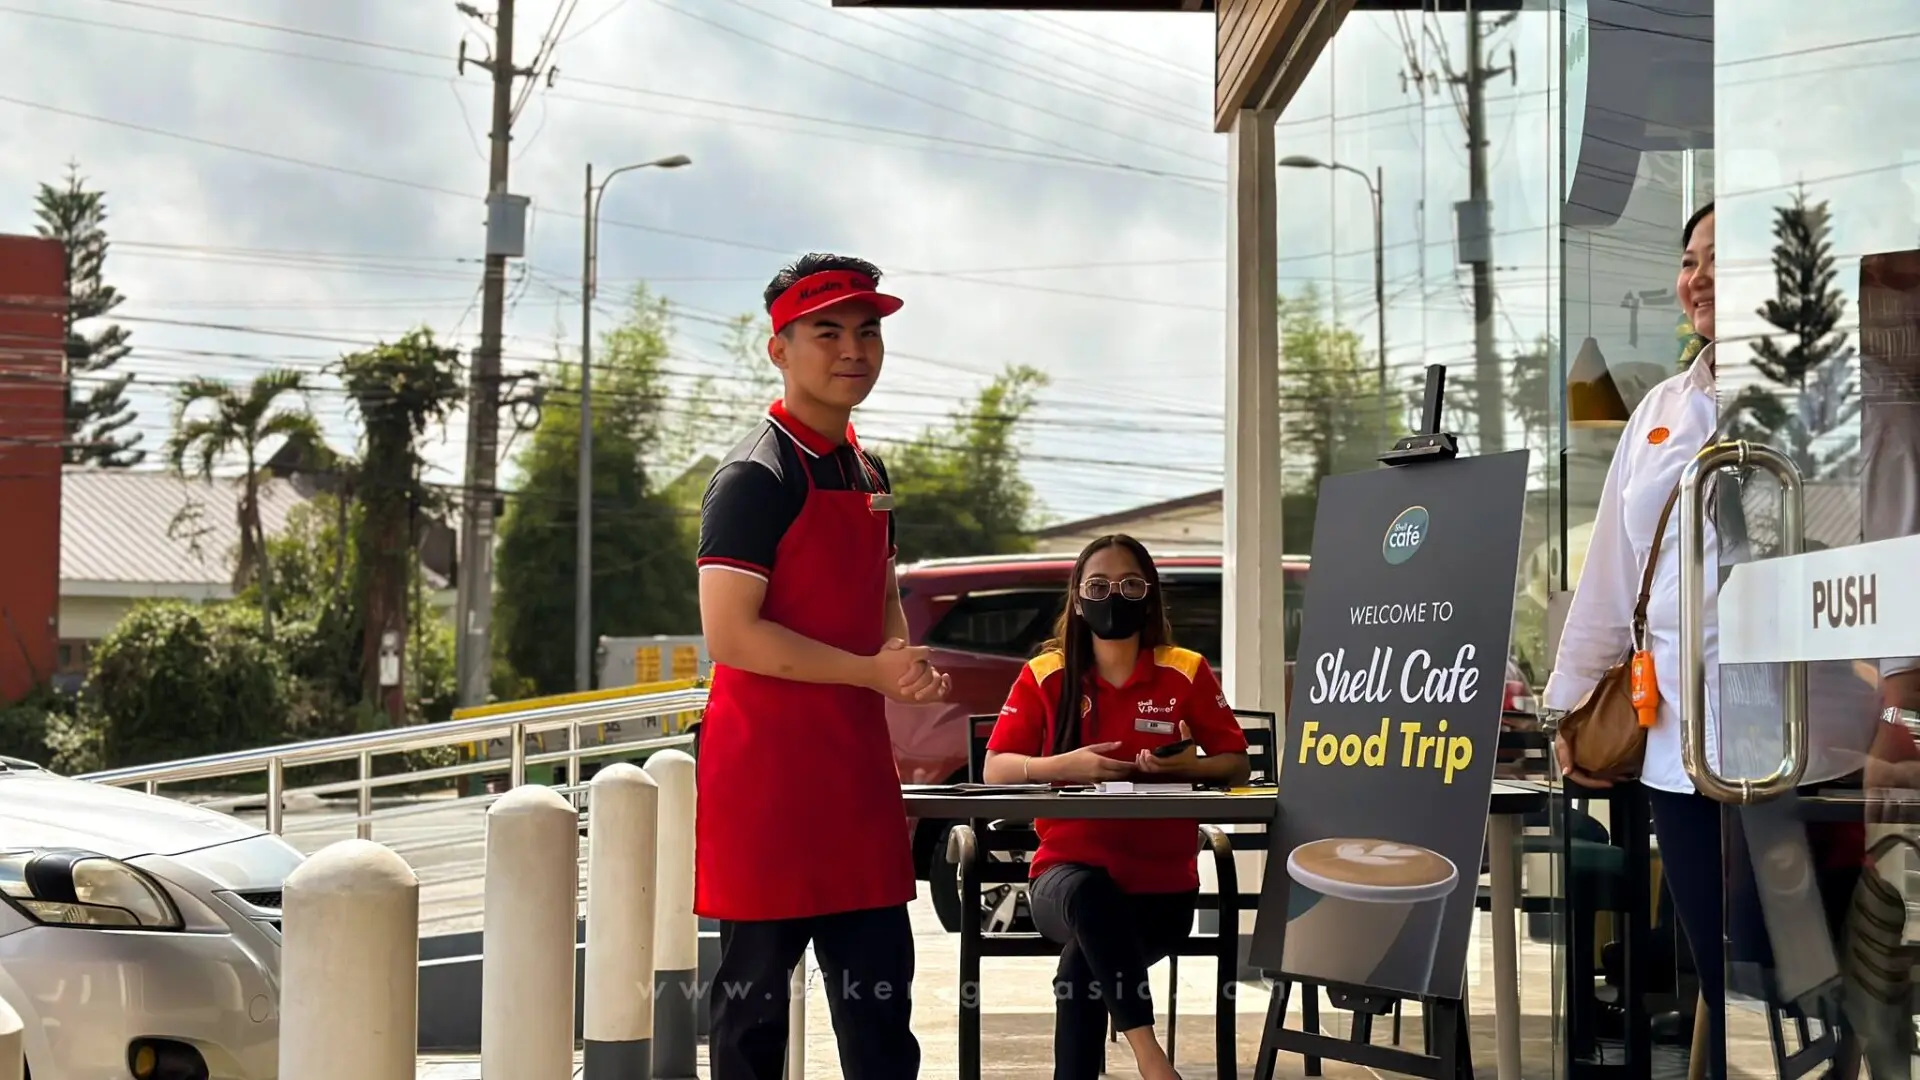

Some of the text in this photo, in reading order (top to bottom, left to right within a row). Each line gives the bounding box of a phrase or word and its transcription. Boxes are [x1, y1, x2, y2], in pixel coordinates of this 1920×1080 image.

[1389, 524, 1420, 548] café
[1395, 522, 1408, 531] Shell
[1350, 601, 1453, 625] WELCOME TO
[1812, 573, 1877, 629] PUSH
[1309, 643, 1480, 704] Shell Cafe
[1298, 717, 1473, 785] Food Trip
